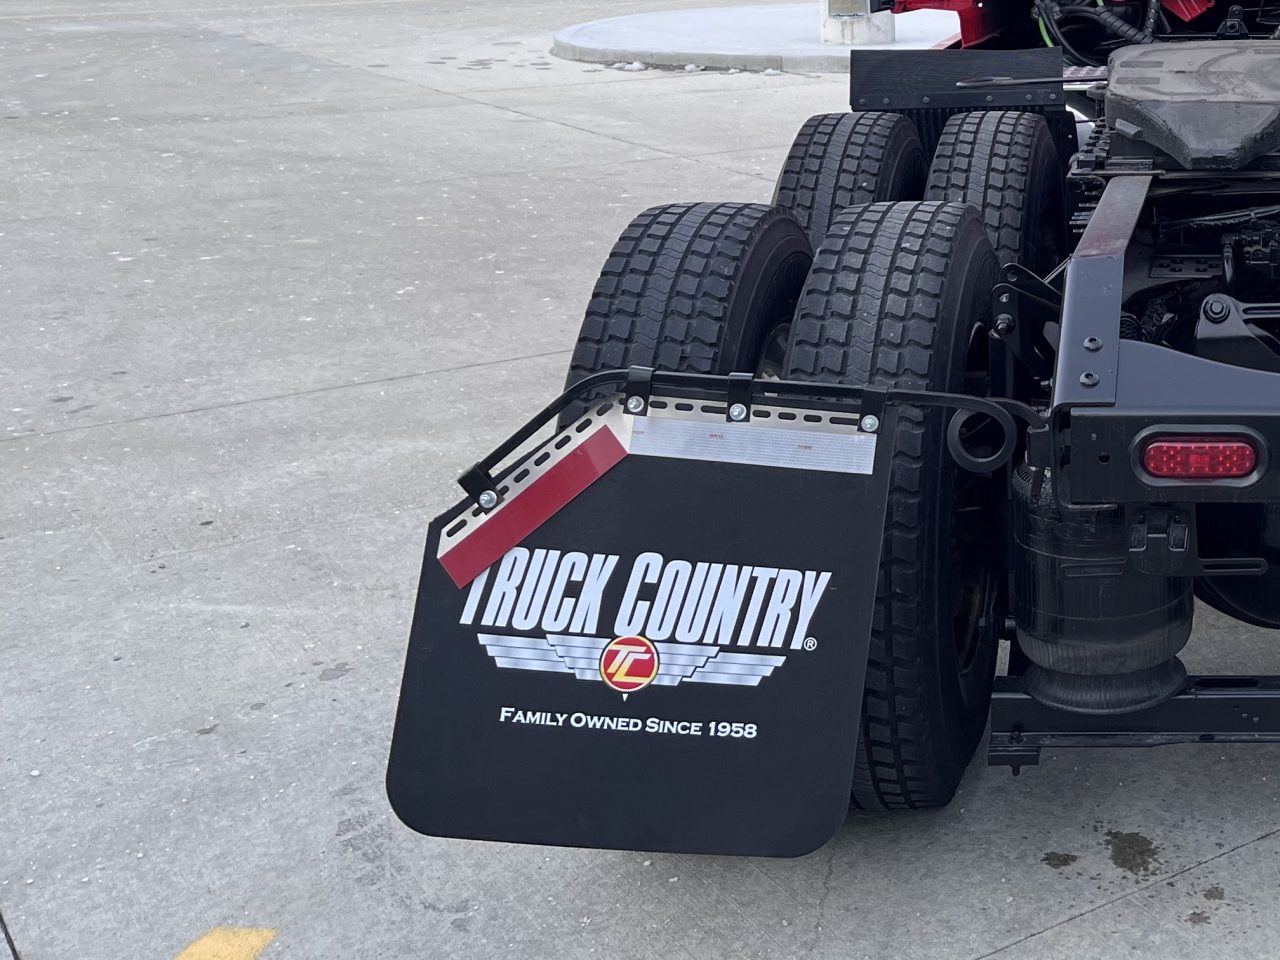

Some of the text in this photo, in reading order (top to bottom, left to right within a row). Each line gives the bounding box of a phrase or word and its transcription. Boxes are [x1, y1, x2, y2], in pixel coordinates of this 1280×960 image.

[613, 551, 833, 650] COUNTRY
[499, 706, 758, 739] FAMILY OWNED SINCE 1958
